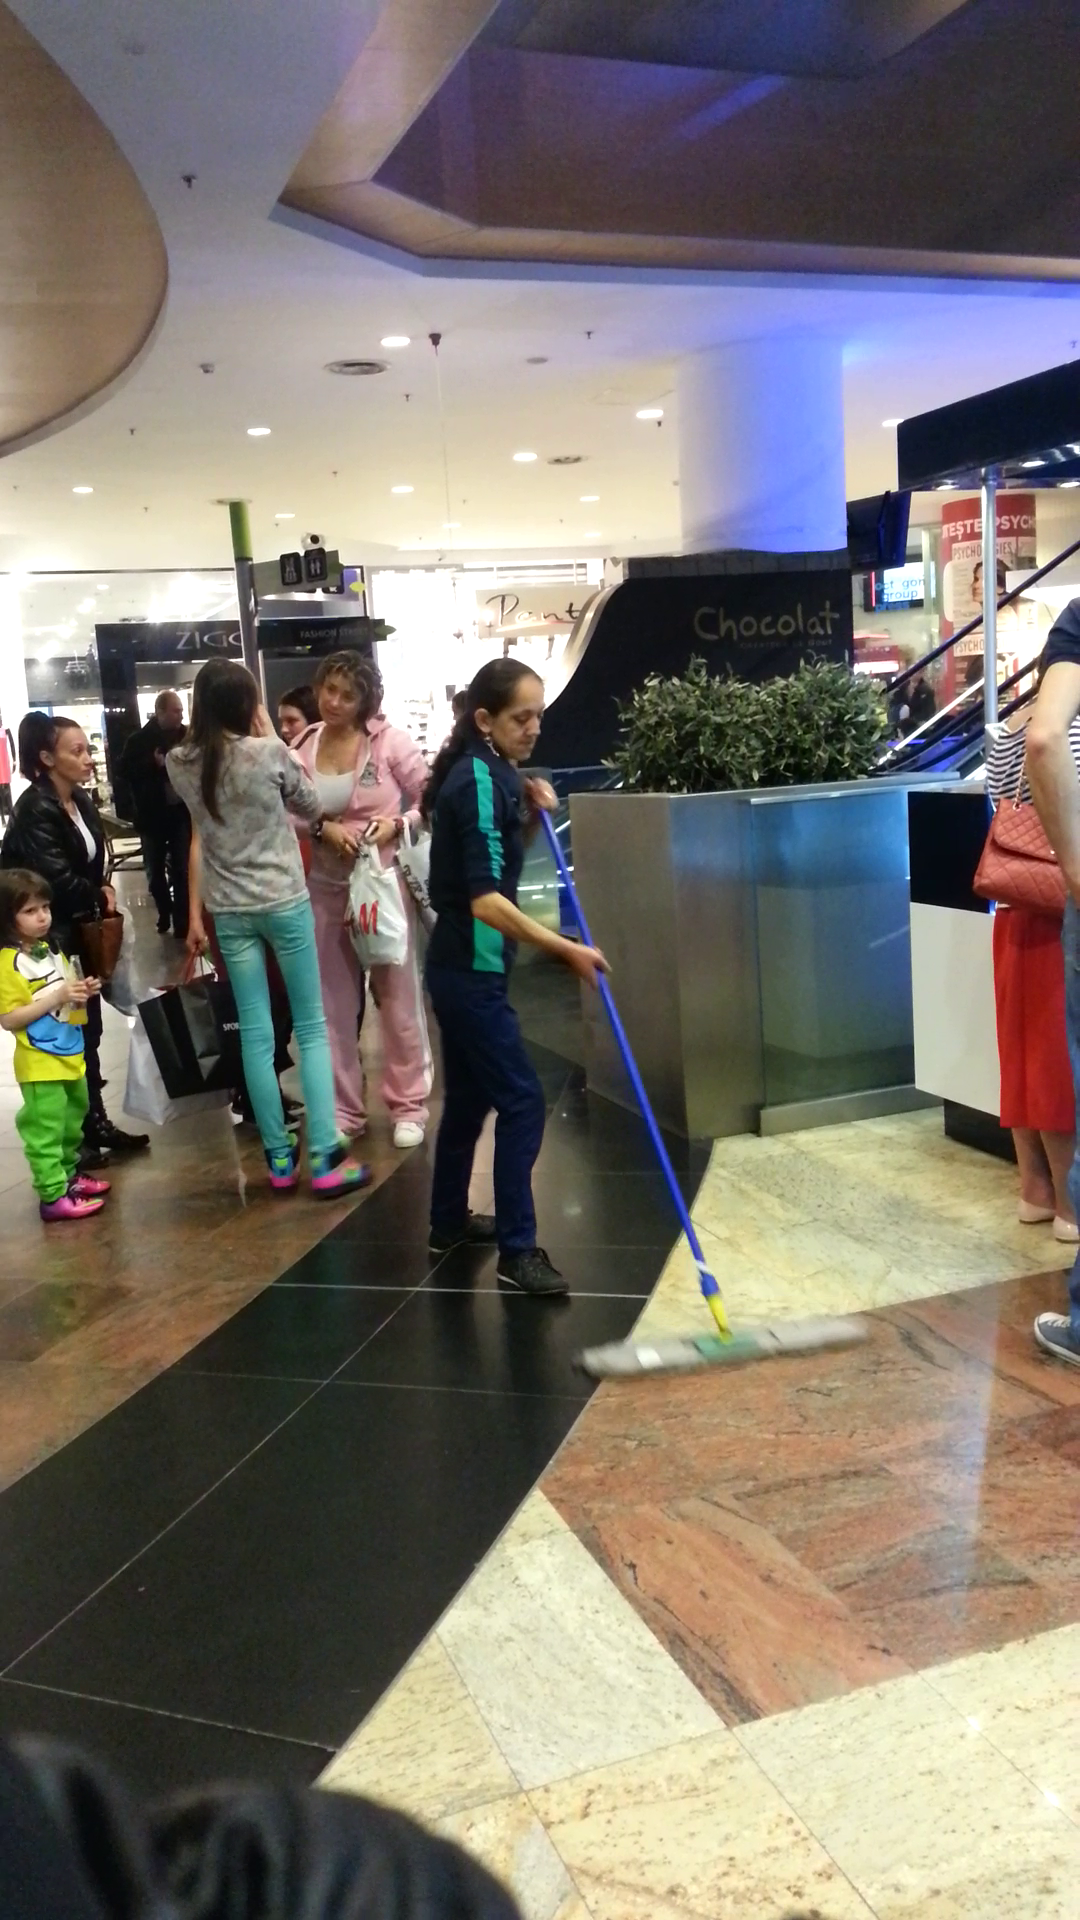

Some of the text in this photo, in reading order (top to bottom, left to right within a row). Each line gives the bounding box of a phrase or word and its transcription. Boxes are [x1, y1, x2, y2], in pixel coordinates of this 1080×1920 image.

[883, 590, 918, 602] group
[694, 600, 840, 641] Chocolat
[300, 628, 337, 639] FASHION
